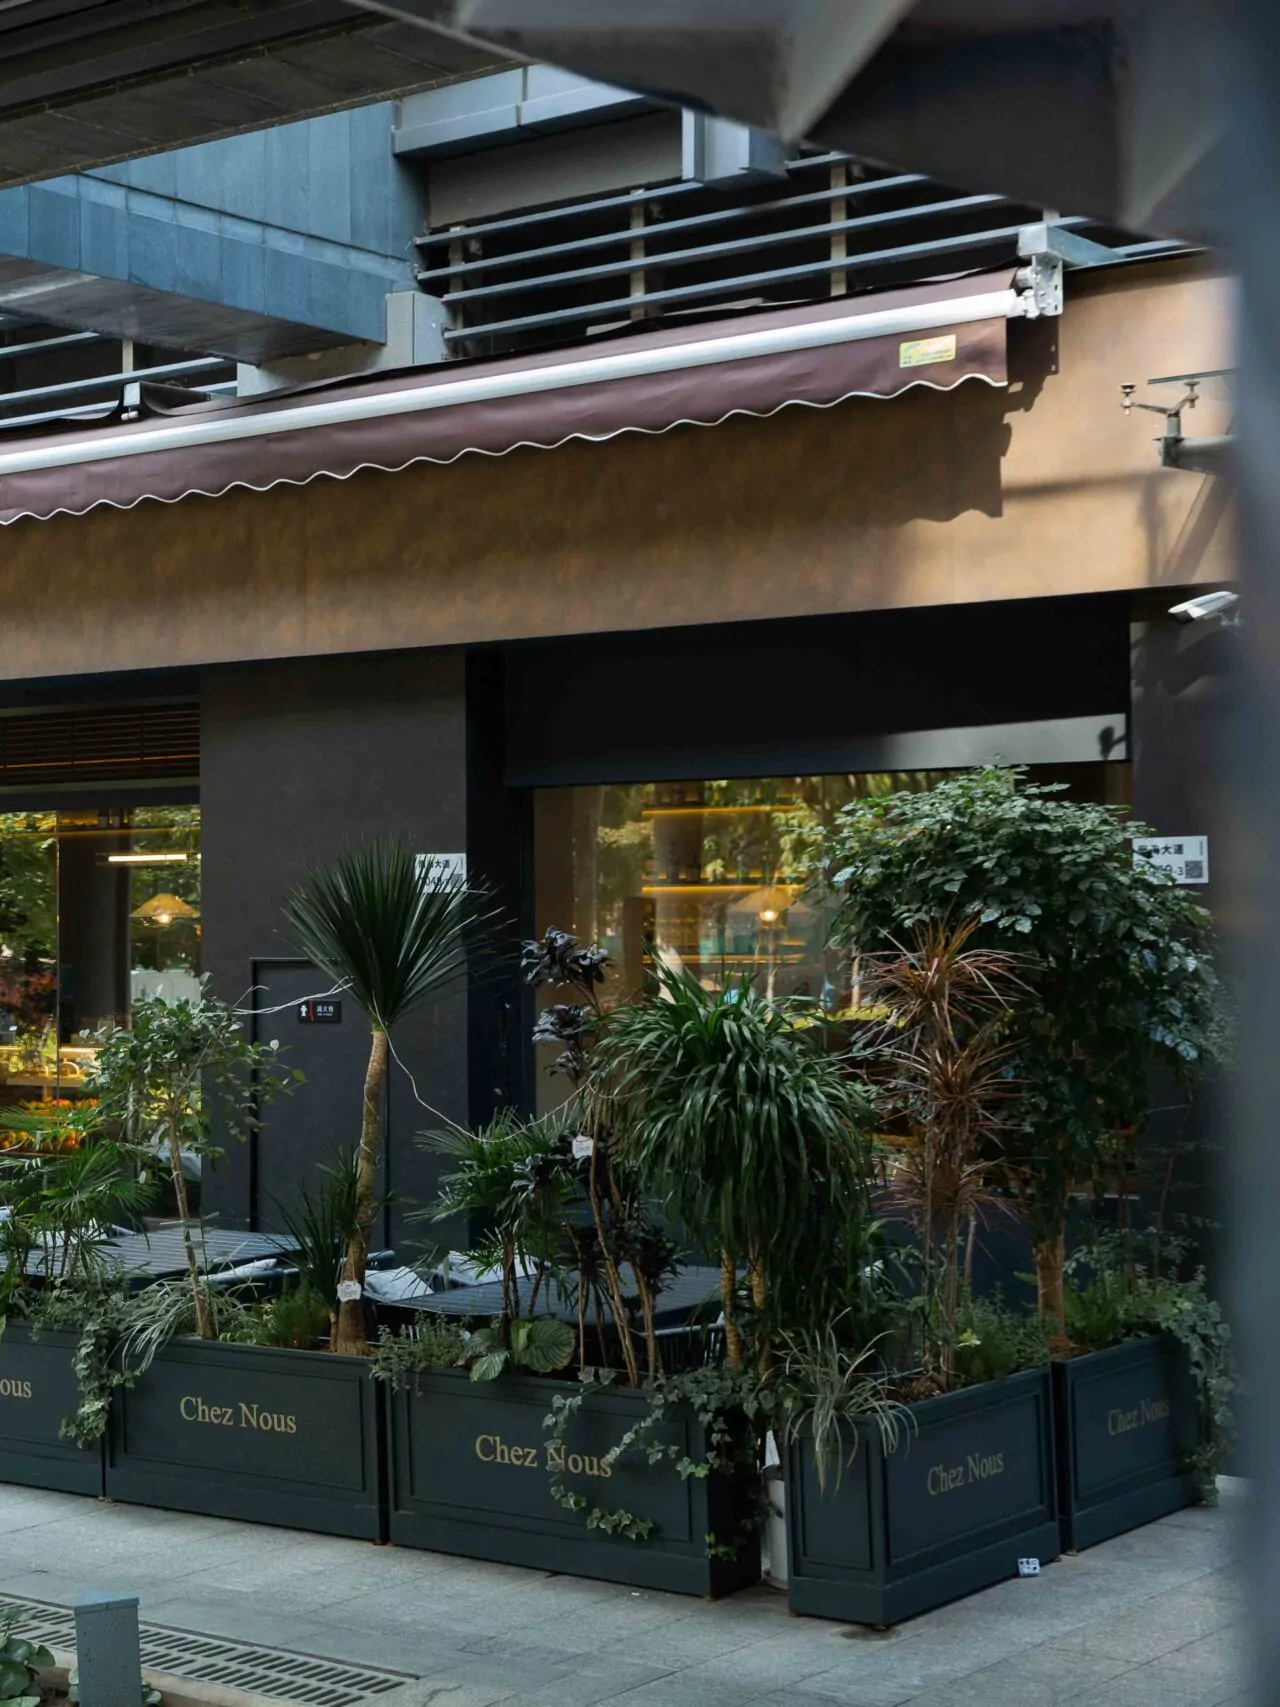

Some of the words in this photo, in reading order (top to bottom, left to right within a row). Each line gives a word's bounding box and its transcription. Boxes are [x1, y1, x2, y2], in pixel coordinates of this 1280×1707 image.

[180, 1396, 234, 1426] Chez
[238, 1402, 297, 1434] Nous
[475, 1434, 538, 1467] Chez
[546, 1444, 613, 1478] Nous
[927, 1464, 964, 1496] Chez
[966, 1452, 1004, 1484] Nous
